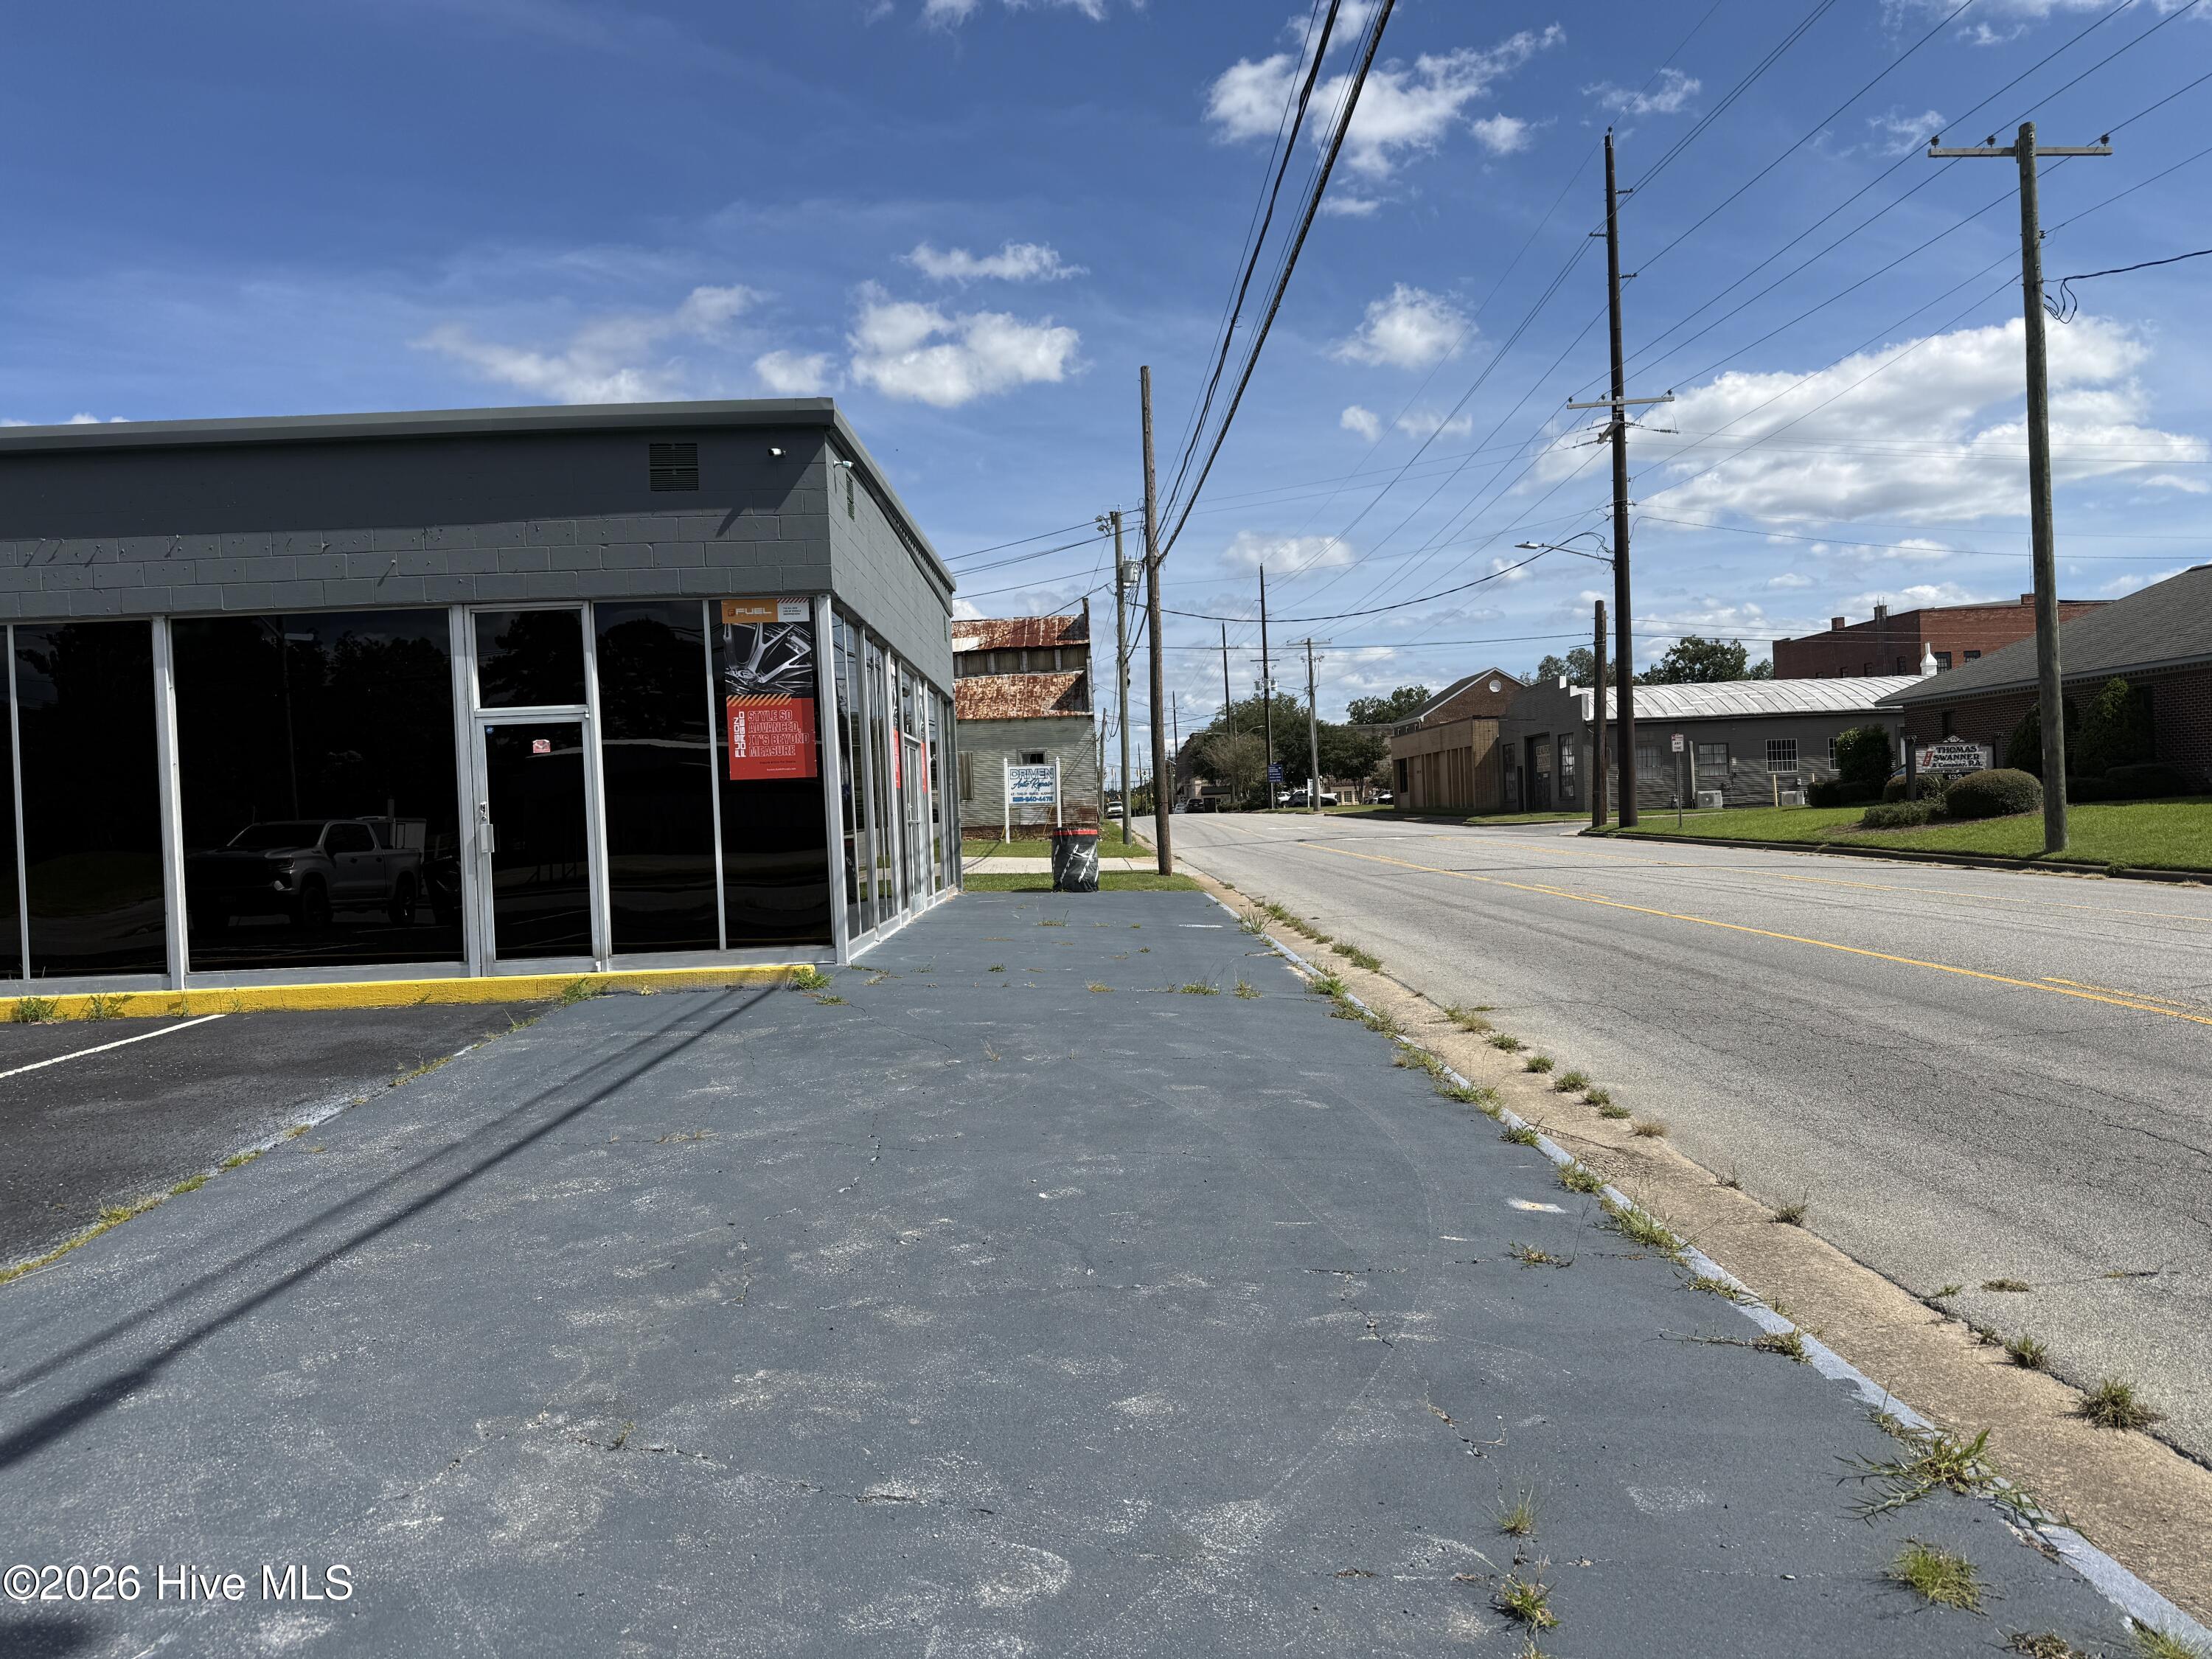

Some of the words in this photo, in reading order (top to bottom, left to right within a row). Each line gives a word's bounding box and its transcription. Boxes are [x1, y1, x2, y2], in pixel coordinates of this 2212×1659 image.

[748, 710, 778, 722] STYLE
[779, 709, 793, 721] SO
[748, 721, 801, 734] ADVANCED,
[748, 734, 770, 745] IT'S
[771, 733, 810, 745] BEYOND
[749, 745, 796, 757] MEASURE
[1935, 745, 1978, 754] THOMAS
[1009, 768, 1054, 779] DRIVEN
[1011, 778, 1030, 790] Auto
[1031, 778, 1053, 791] Repair
